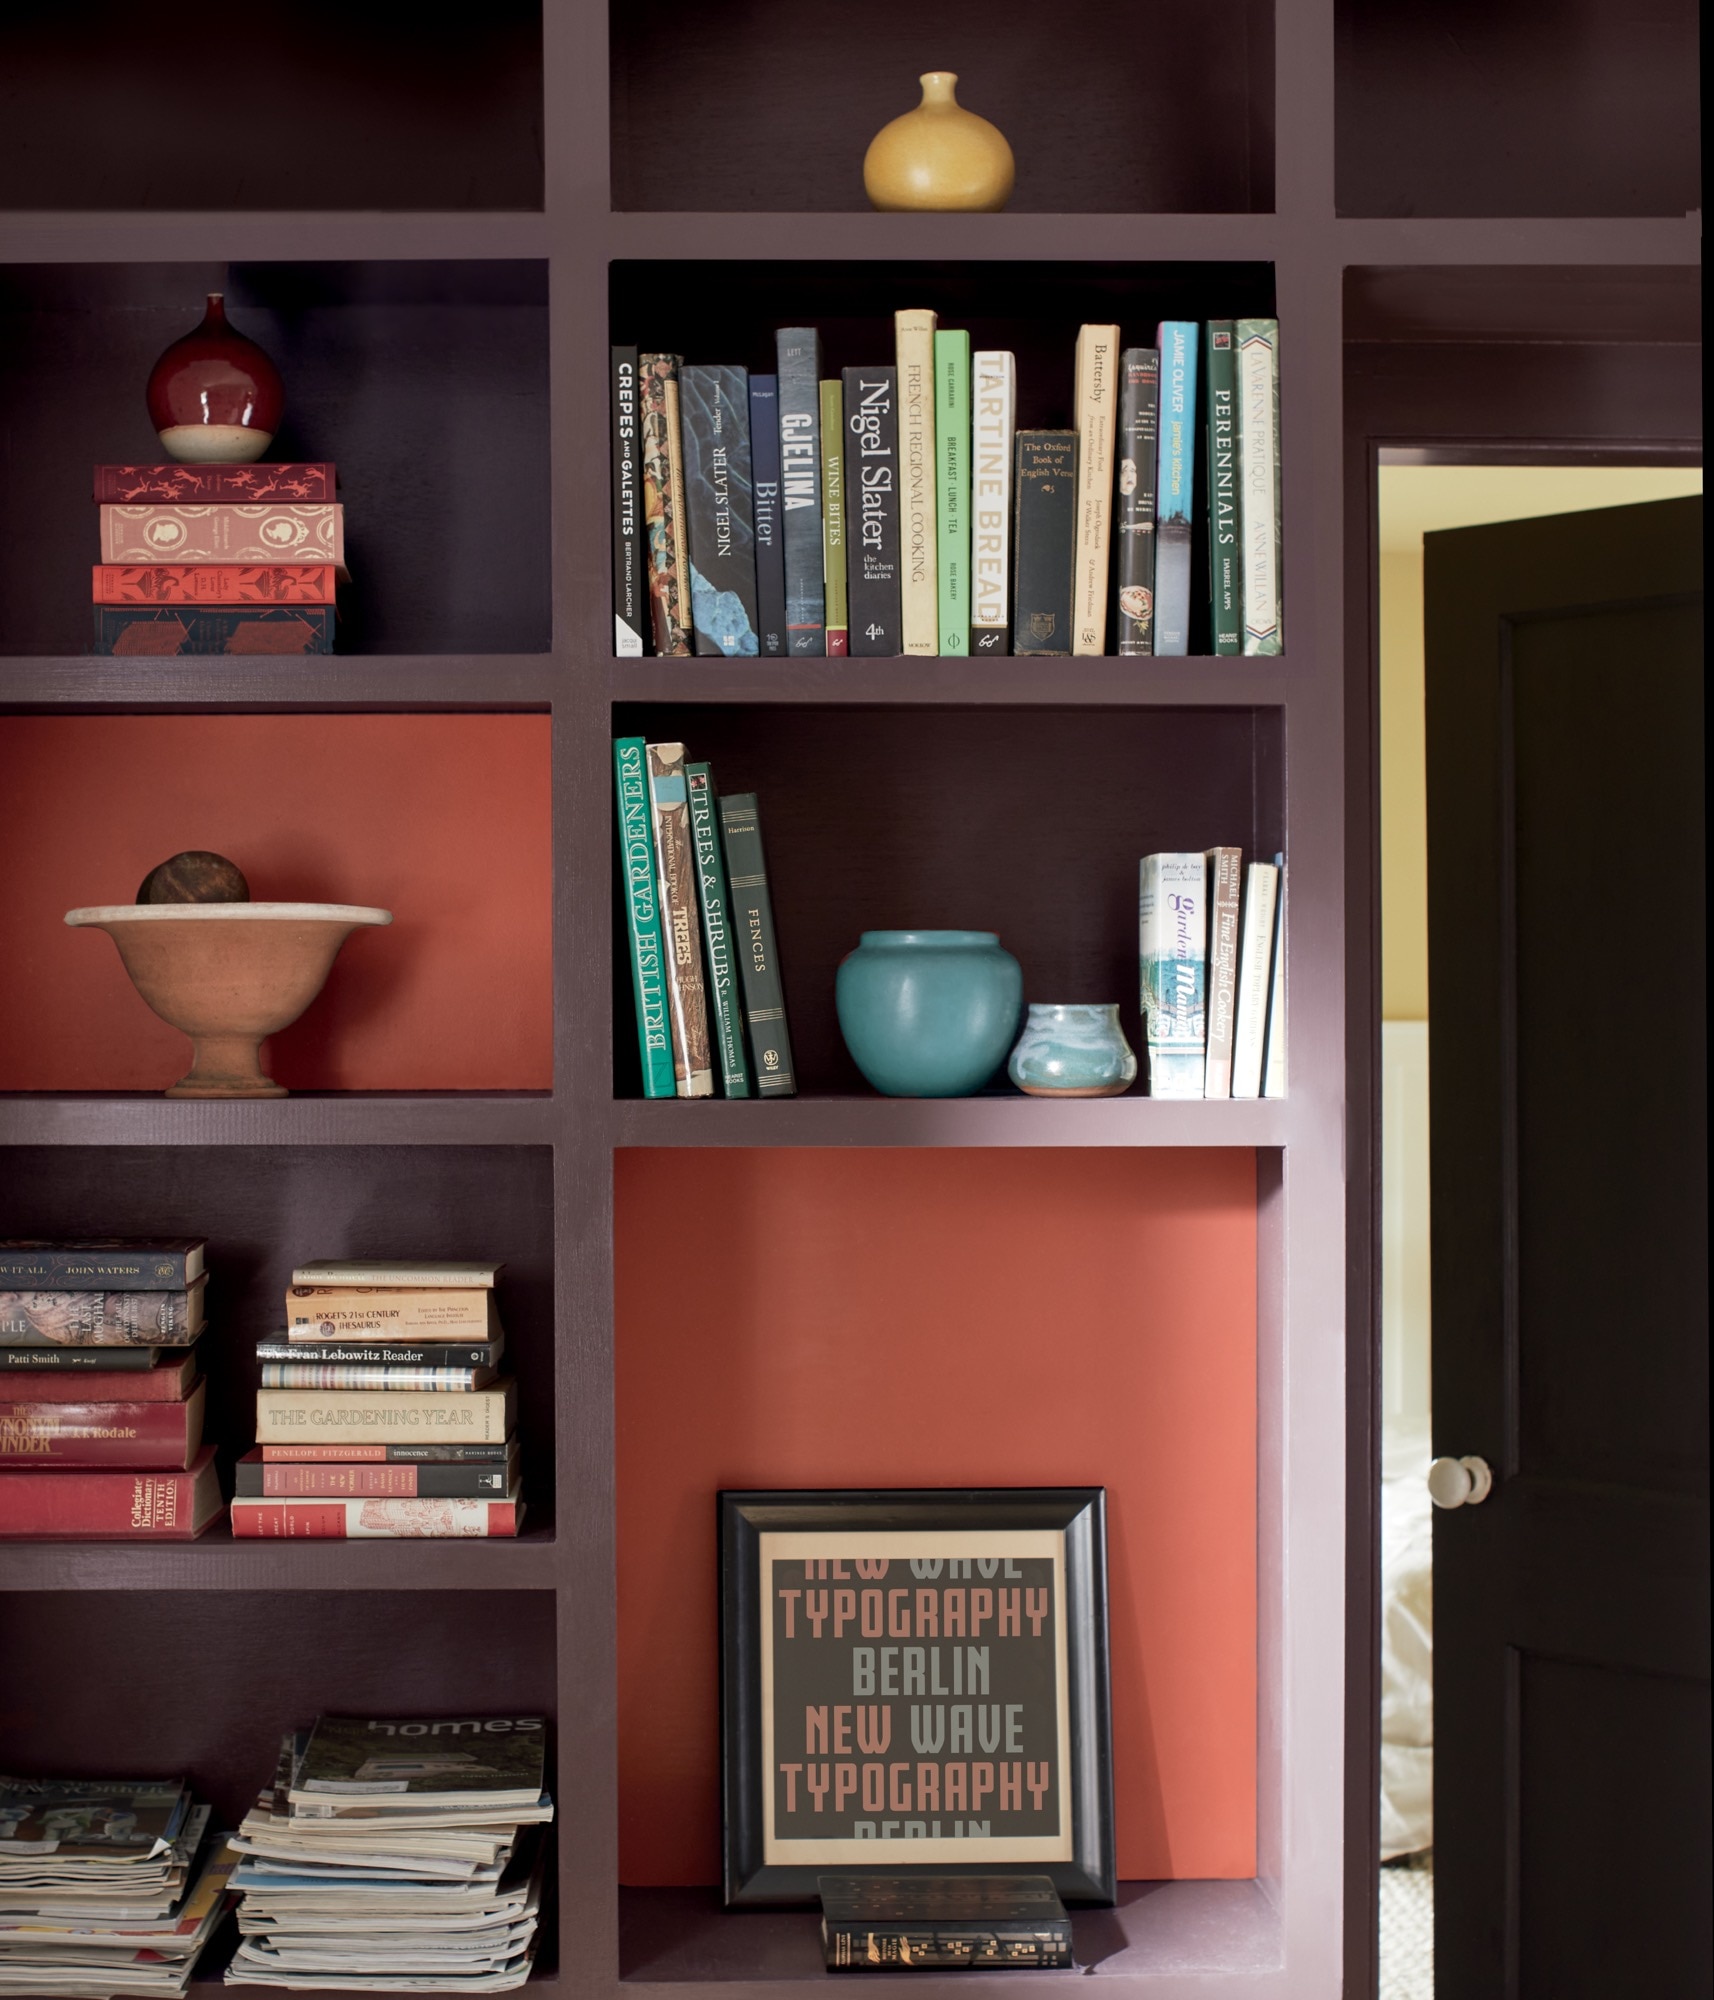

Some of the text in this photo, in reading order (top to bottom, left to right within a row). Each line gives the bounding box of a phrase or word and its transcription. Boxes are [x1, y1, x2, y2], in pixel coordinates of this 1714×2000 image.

[947, 362, 955, 376] ROSE
[1089, 344, 1108, 404] Battersby
[1172, 330, 1185, 413] JAMIE OLIVER
[752, 391, 774, 399] McLagan
[713, 408, 722, 435] Tender
[979, 353, 1004, 496] TARTINE
[619, 363, 634, 535] CREPES AND GALETTES
[781, 413, 815, 511] GJELINA
[850, 379, 893, 551] Nigel Slater
[1024, 443, 1071, 452] The Oxford
[1033, 455, 1065, 464] Book of
[1087, 438, 1095, 466] Ordinary
[1097, 457, 1105, 472] Food
[1171, 421, 1183, 496] jamie's kitchen
[1215, 389, 1234, 544] PERENNIALS
[1252, 431, 1266, 496] PRATIQUE
[908, 364, 925, 583] FRENCH REGIONAL COOKING
[947, 437, 957, 534] BREAKFAST LUNCH TEA
[1021, 468, 1073, 480] English Verse
[713, 446, 731, 557] NIGEL SLATER
[756, 482, 778, 546] Bitter
[828, 456, 841, 546] WINE BITES
[1095, 499, 1103, 519] Joseph
[624, 541, 633, 617] BERTRAND LARCHER
[863, 554, 877, 563] the
[863, 562, 894, 571] kitchen
[863, 571, 891, 580] diaries
[978, 511, 1003, 620] BREAD
[1254, 521, 1268, 612] ANNE WILLAN
[1087, 566, 1096, 618] Andrew Friedman
[1223, 558, 1232, 610] DARREL APPS
[865, 623, 885, 641] 4th
[664, 815, 676, 872] INTERNATIONAL
[728, 825, 755, 834] Harrison
[692, 793, 731, 988] TREES & SHRUBS
[1220, 855, 1229, 884] SMITH
[1228, 855, 1239, 899] MICHAEL
[620, 746, 666, 1050] BRITISH GARDENERS
[672, 906, 692, 965] TREES
[748, 908, 766, 972] FENCES
[1219, 912, 1236, 941] Fine
[676, 975, 697, 983] HUGH
[1215, 942, 1234, 988] English
[722, 1001, 732, 1033] WILLIAM
[727, 1035, 737, 1068] THOMAS
[1211, 990, 1232, 1042] Cookery
[97, 1267, 140, 1275] WATERS
[389, 1275, 440, 1283] UNCOMMON
[443, 1276, 474, 1284] READER
[69, 1306, 79, 1329] THE
[81, 1305, 92, 1332] LAST
[94, 1291, 105, 1344] MUGHAL
[316, 1310, 400, 1320] ROGET'S CENTURY
[339, 1321, 381, 1331] THESAURUS
[8, 1354, 60, 1364] Patti Smith
[288, 1348, 318, 1359] Fran
[322, 1349, 380, 1360] Lebowitz
[383, 1350, 424, 1361] Reader
[13, 1407, 27, 1416] THE
[93, 1427, 137, 1439] Rodale
[269, 1410, 474, 1425] THE GARDENING YEAR
[271, 1449, 381, 1457] PENELOPE FITZGERALD
[131, 1478, 144, 1528] Collegiate
[142, 1478, 154, 1527] Dictionary
[156, 1483, 165, 1522] TENTH
[165, 1479, 175, 1527] EDITION
[779, 1588, 1048, 1638] TYPOGRAPHY
[853, 1646, 990, 1696] BERLIN
[368, 1718, 543, 1737] homes
[806, 1704, 1024, 1754] NEW WAVE
[780, 1761, 1049, 1812] TYPOGRAPHY
